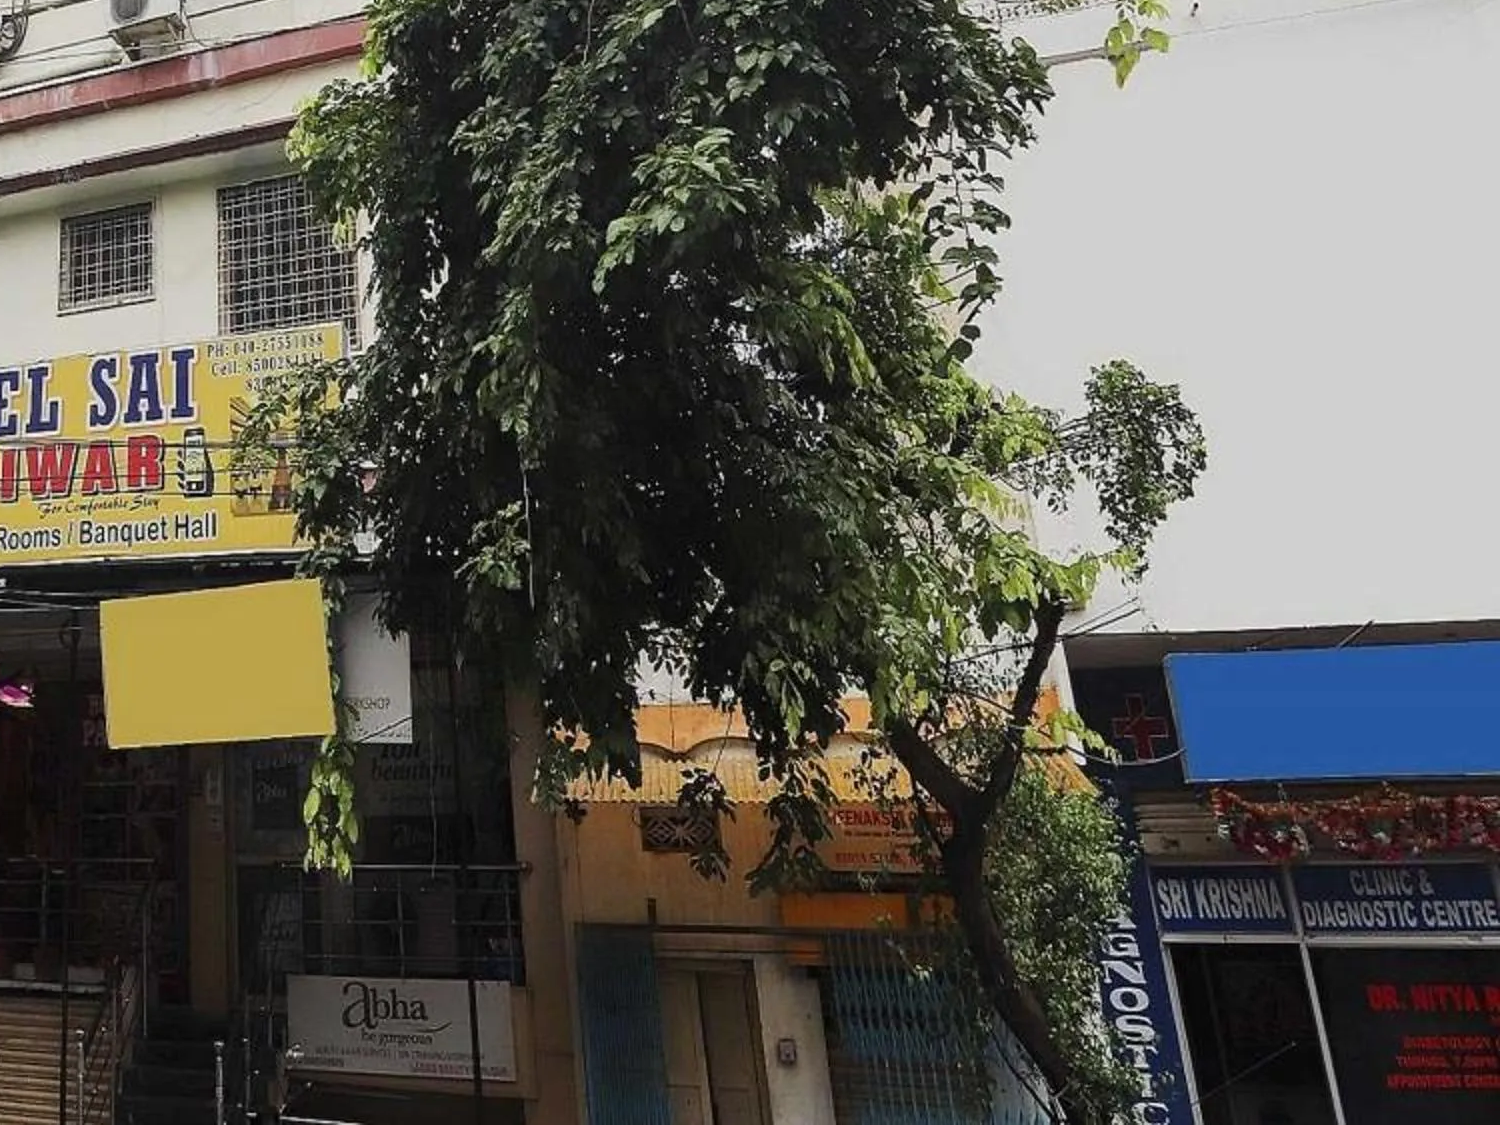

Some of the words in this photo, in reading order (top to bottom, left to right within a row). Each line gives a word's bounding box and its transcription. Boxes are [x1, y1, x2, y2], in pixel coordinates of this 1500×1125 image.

[88, 347, 196, 427] SAI
[79, 514, 169, 548] Banquet
[174, 512, 217, 540] Hall
[1157, 878, 1193, 919] SRI
[1193, 878, 1286, 920] KRISHNA
[1350, 869, 1415, 896] CLINIC
[1418, 869, 1436, 895] &
[1302, 900, 1418, 927] DIAGNOSTIC
[1420, 899, 1500, 926] CENTRE
